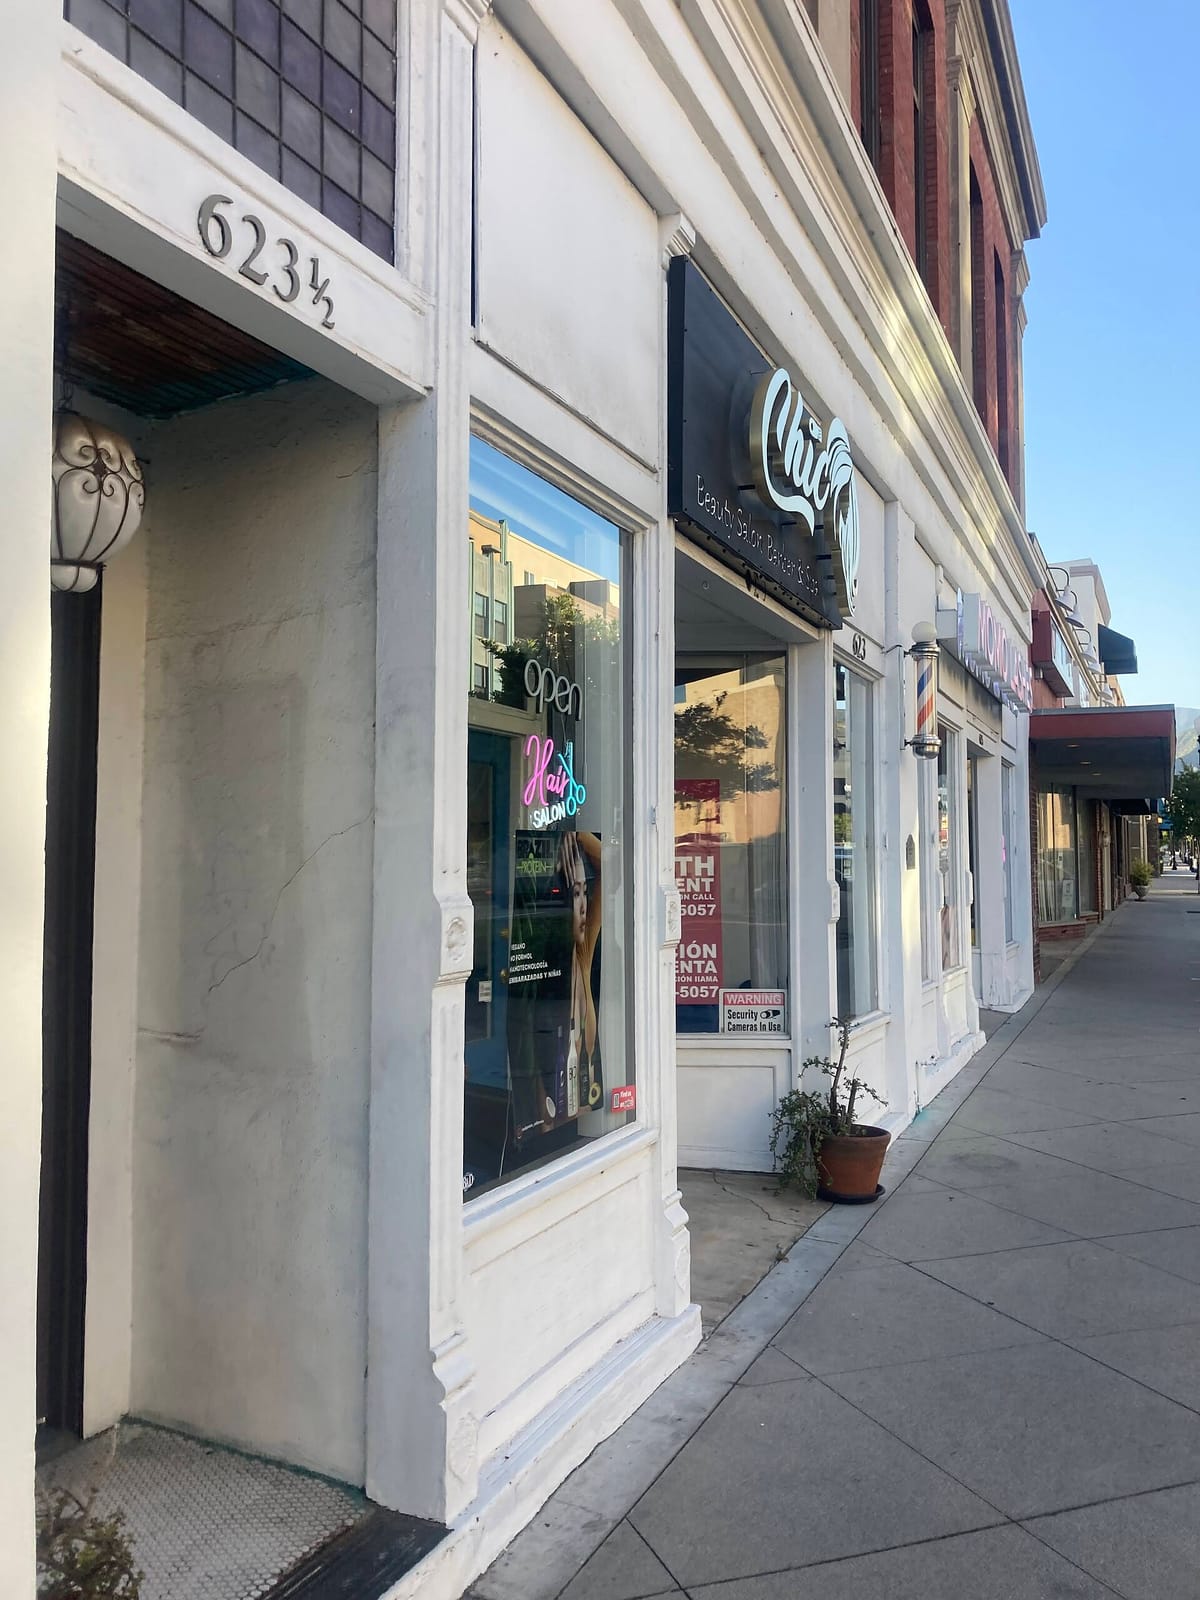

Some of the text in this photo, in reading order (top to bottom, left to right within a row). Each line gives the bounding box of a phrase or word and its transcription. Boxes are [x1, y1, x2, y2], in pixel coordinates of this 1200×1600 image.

[696, 474, 735, 539] Beauty
[737, 507, 763, 554] Salon
[852, 632, 867, 660] 623
[524, 734, 569, 806] Hair
[532, 801, 566, 829] SALON
[675, 855, 715, 877] TH
[692, 893, 715, 901] CALL
[681, 904, 717, 916] 5057
[675, 940, 718, 959] IÓN
[726, 994, 781, 1005] WARNING
[727, 1009, 758, 1021] Security
[727, 1021, 782, 1032] Cameras In Use
